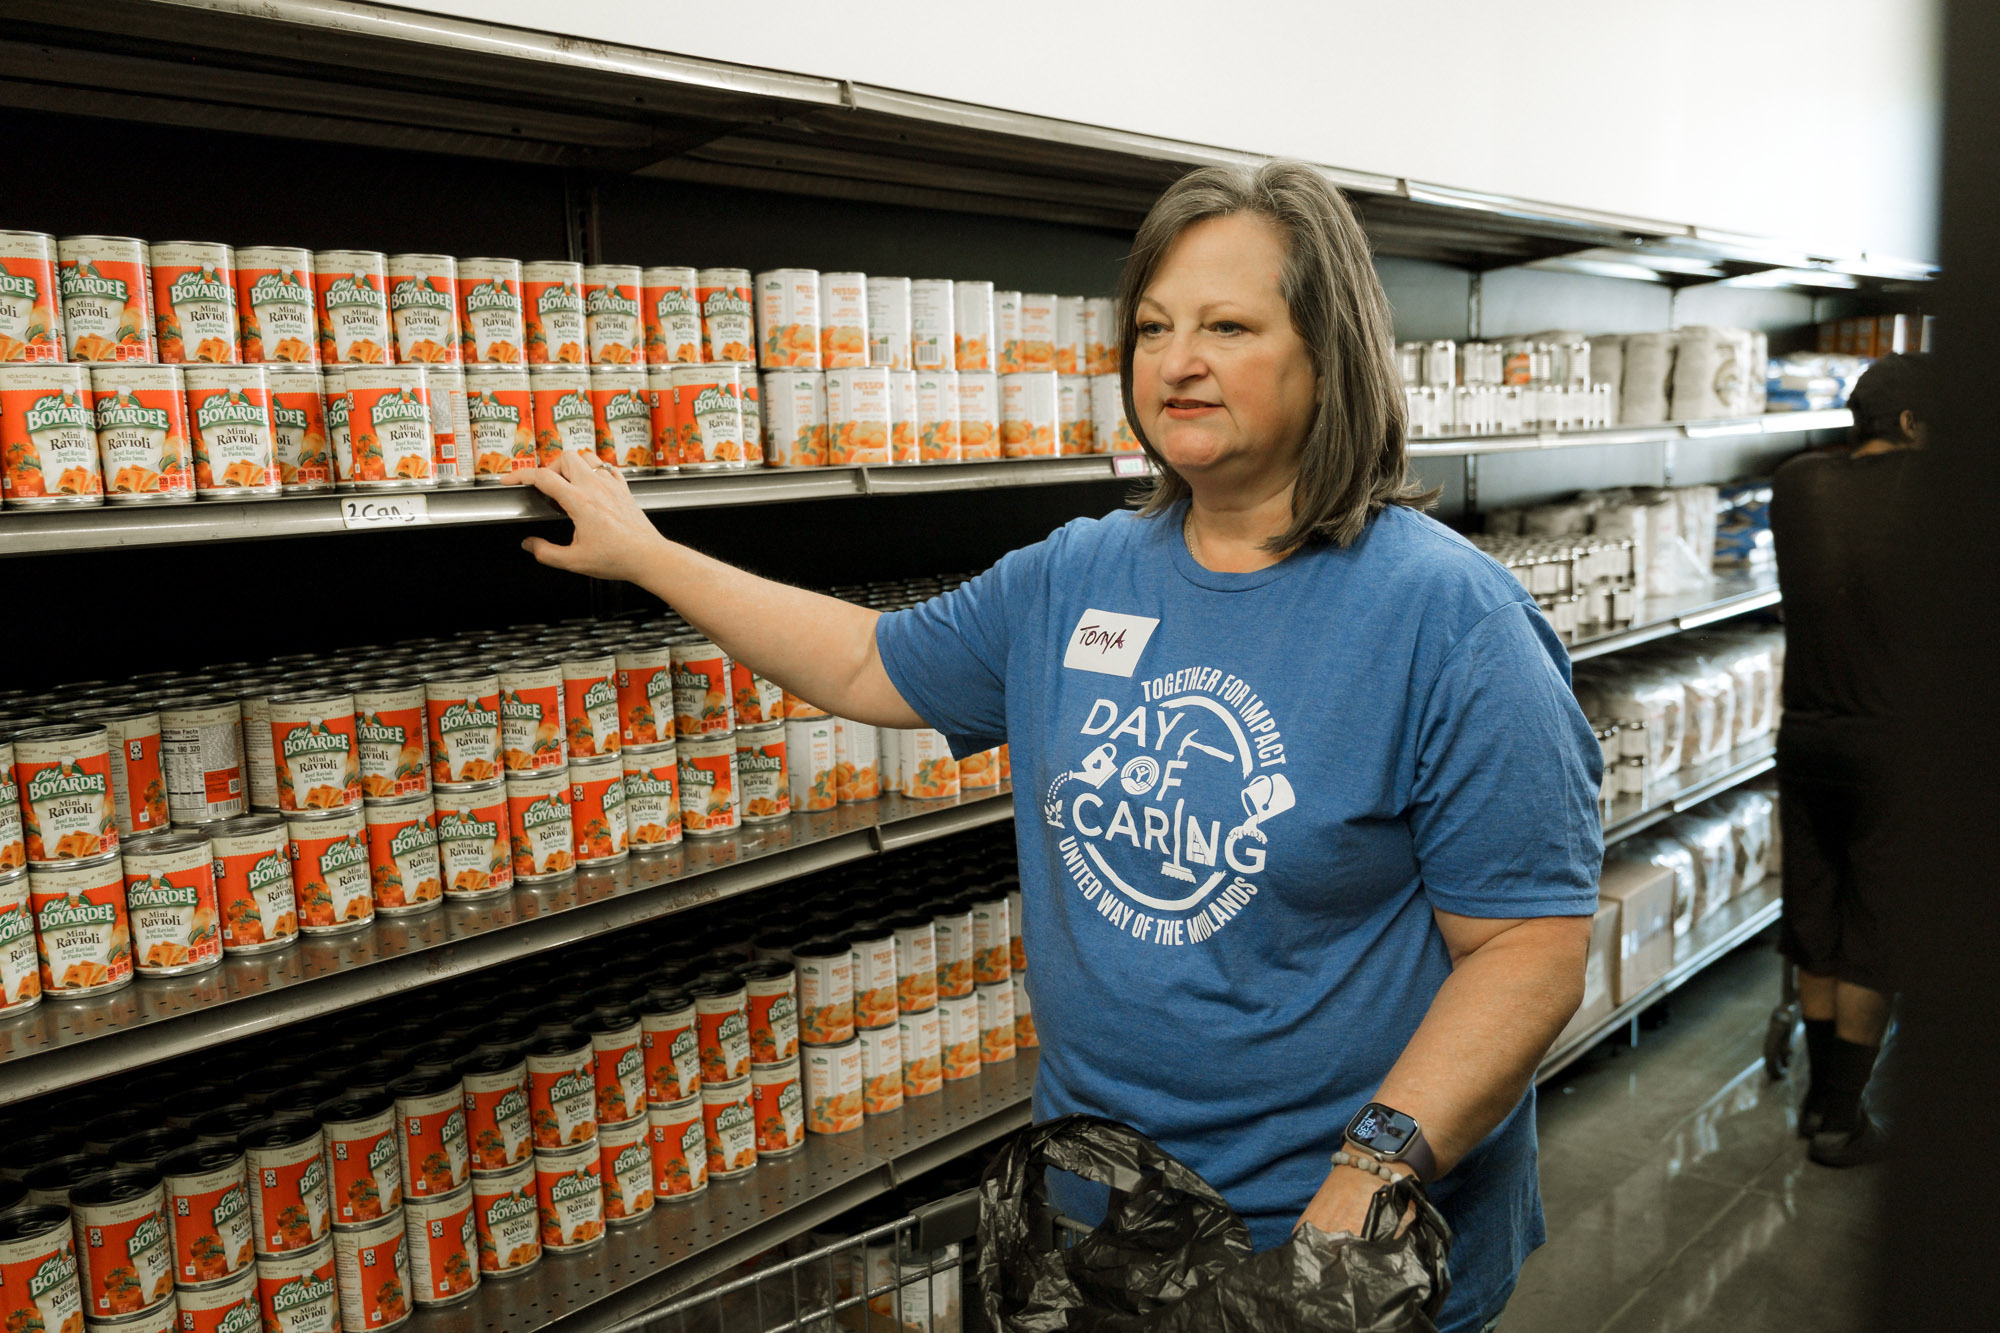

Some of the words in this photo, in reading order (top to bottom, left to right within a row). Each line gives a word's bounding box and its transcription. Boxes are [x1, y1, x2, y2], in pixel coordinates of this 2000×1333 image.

[178, 273, 201, 286] Chef
[257, 276, 280, 288] Chef
[63, 278, 127, 300] OYARDEE
[332, 280, 352, 292] Chef
[396, 282, 414, 294] Chef
[473, 284, 493, 296] Chef
[544, 288, 563, 298] Chef
[76, 300, 95, 308] Mini
[69, 306, 108, 319] Ravioli
[190, 311, 229, 323] Ravioli
[269, 312, 306, 324] Ravioli
[342, 315, 379, 326] Ravioli
[404, 316, 440, 327] Ravioli
[482, 318, 515, 328] Ravioli
[596, 321, 628, 331] Ravioli
[378, 395, 400, 406] Chef
[612, 395, 629, 405] Chef
[700, 389, 718, 400] Chef
[35, 398, 60, 410] Chef
[98, 398, 116, 410] Chef
[204, 396, 227, 408] Chef
[560, 396, 576, 406] Chef
[470, 405, 519, 422] OYARDEE
[216, 433, 258, 446] Ravioli
[390, 430, 424, 441] Ravioli
[473, 428, 506, 440] Ravioli
[50, 438, 91, 450] Ravioli
[108, 438, 151, 450] Ravioli
[446, 706, 466, 718] Chef
[1141, 666, 1222, 702] TOGETHER
[1216, 674, 1250, 708] FOR
[1239, 694, 1286, 768] IMPACT
[440, 712, 498, 732] BOYARDEE
[1080, 698, 1186, 751] DAY
[289, 727, 308, 740] Chef
[358, 726, 404, 743] YARDEE
[284, 734, 349, 756] BOYARDEE
[456, 736, 489, 748] Ravioli
[300, 760, 337, 773] Ravioli
[738, 757, 781, 769] OYARDEE
[35, 770, 59, 782] Chef
[28, 774, 106, 800] BOYARDEE
[626, 780, 672, 794] OYARDEE
[59, 799, 80, 808] Mini
[530, 802, 547, 812] Chef
[630, 804, 662, 813] Ravioli
[48, 804, 92, 820] Ravioli
[442, 816, 458, 826] Chef
[398, 827, 418, 839] Chef
[438, 822, 496, 840] BOYARDEE
[540, 829, 568, 841] Ravioli
[1072, 792, 1268, 884] CARING
[328, 844, 348, 856] Chef
[450, 847, 484, 858] Ravioli
[256, 856, 276, 870] Chef
[348, 868, 362, 876] Mini
[131, 880, 148, 892] Chef
[276, 882, 288, 891] Mini
[1058, 835, 1102, 900] UNITED
[1096, 889, 1134, 930] WAY
[1132, 912, 1154, 942] OF
[1155, 919, 1184, 946] THE
[1186, 876, 1258, 944] MIDLANDS
[128, 889, 198, 907] BOYARDEE
[44, 900, 65, 912] Chef
[38, 904, 116, 931] BOYARDEE
[141, 915, 180, 928] Ravioli
[66, 929, 87, 938] Mini
[56, 934, 100, 950] Ravioli
[1358, 1118, 1376, 1136] 10:35
[493, 1196, 512, 1209] Chef
[136, 1218, 156, 1236] Chef
[502, 1222, 532, 1237] Ravioli
[38, 1256, 60, 1276] Chef
[60, 1281, 74, 1293] Mini
[280, 1280, 302, 1296] Chef
[274, 1277, 334, 1311] BOYARDEE
[300, 1304, 317, 1314] Mini
[290, 1306, 328, 1326] Ravioli
